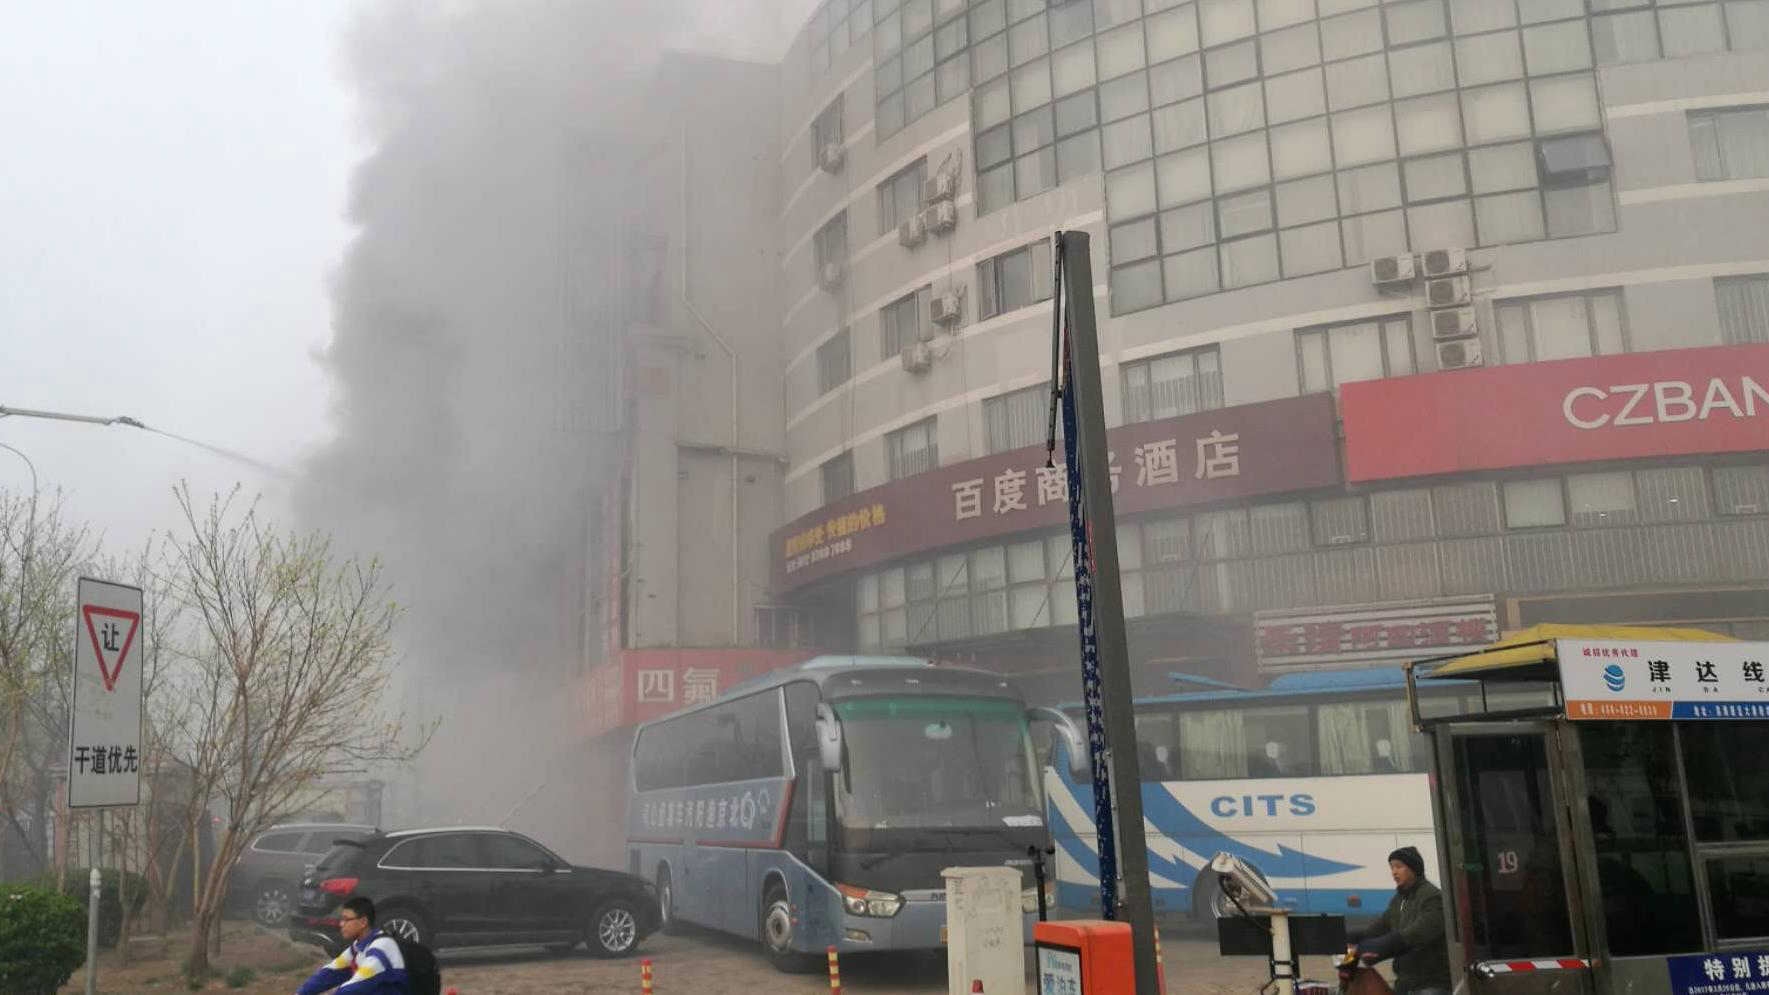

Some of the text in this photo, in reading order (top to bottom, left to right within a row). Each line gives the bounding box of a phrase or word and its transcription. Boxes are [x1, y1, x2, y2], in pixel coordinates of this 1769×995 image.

[101, 622, 120, 651] 让
[1648, 660, 1766, 682] 津达线
[75, 745, 138, 775] 干道优先
[1211, 794, 1316, 817] CITS
[1497, 850, 1518, 874] 19
